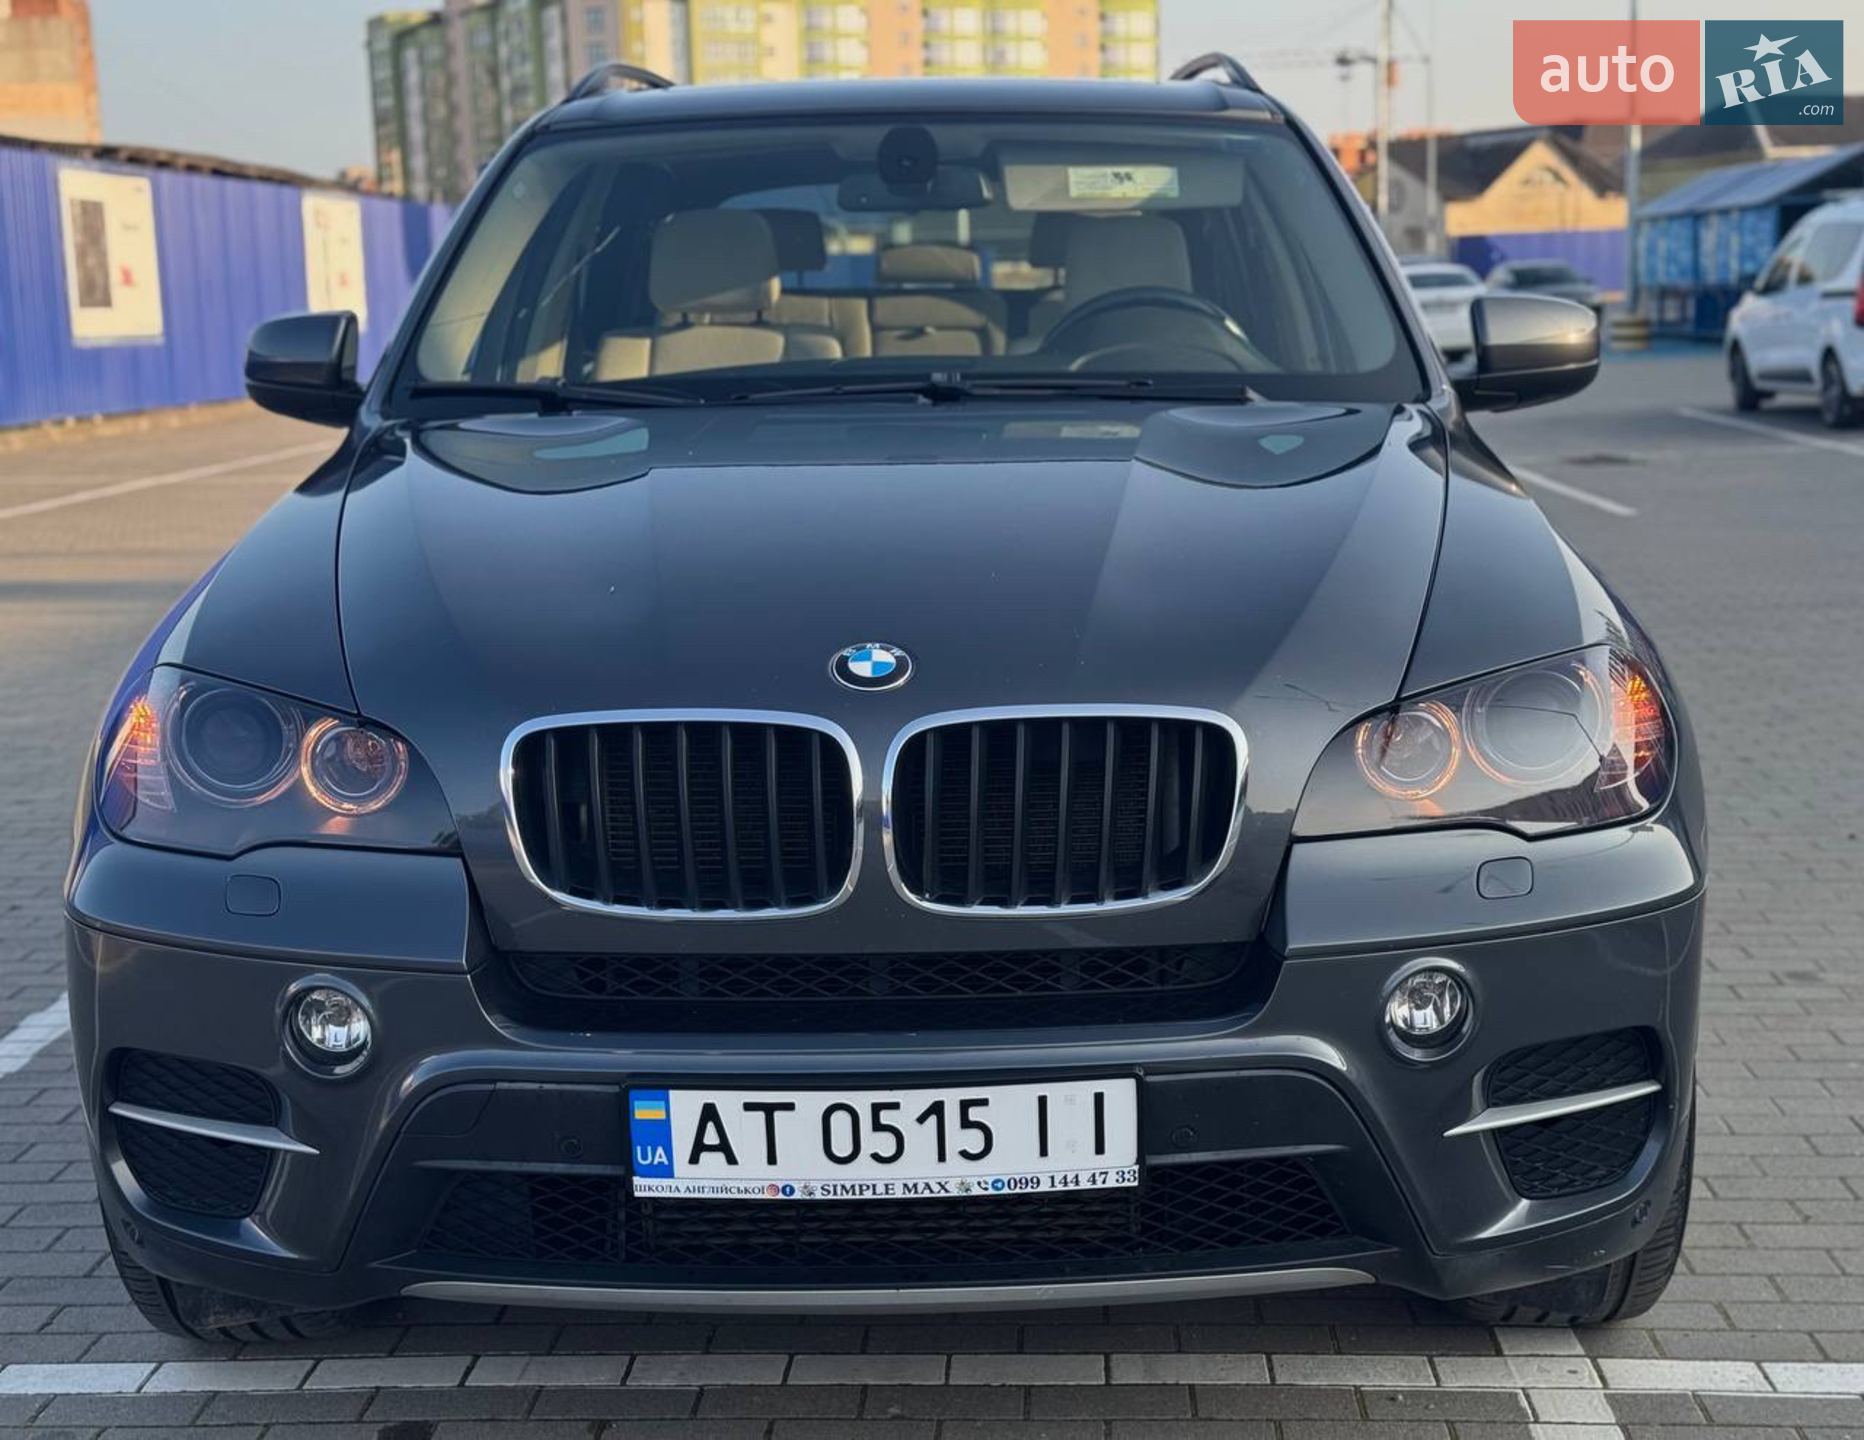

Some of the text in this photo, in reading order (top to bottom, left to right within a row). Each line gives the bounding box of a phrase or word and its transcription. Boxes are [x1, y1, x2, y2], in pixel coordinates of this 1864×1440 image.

[687, 1102, 796, 1166] AT
[821, 1098, 994, 1165] 0515
[636, 1146, 669, 1166] UA
[634, 1183, 681, 1194] ШКОЛА
[820, 1181, 950, 1197] SIMPLE MAX
[1007, 1169, 1138, 1191] 099 144 47 33
